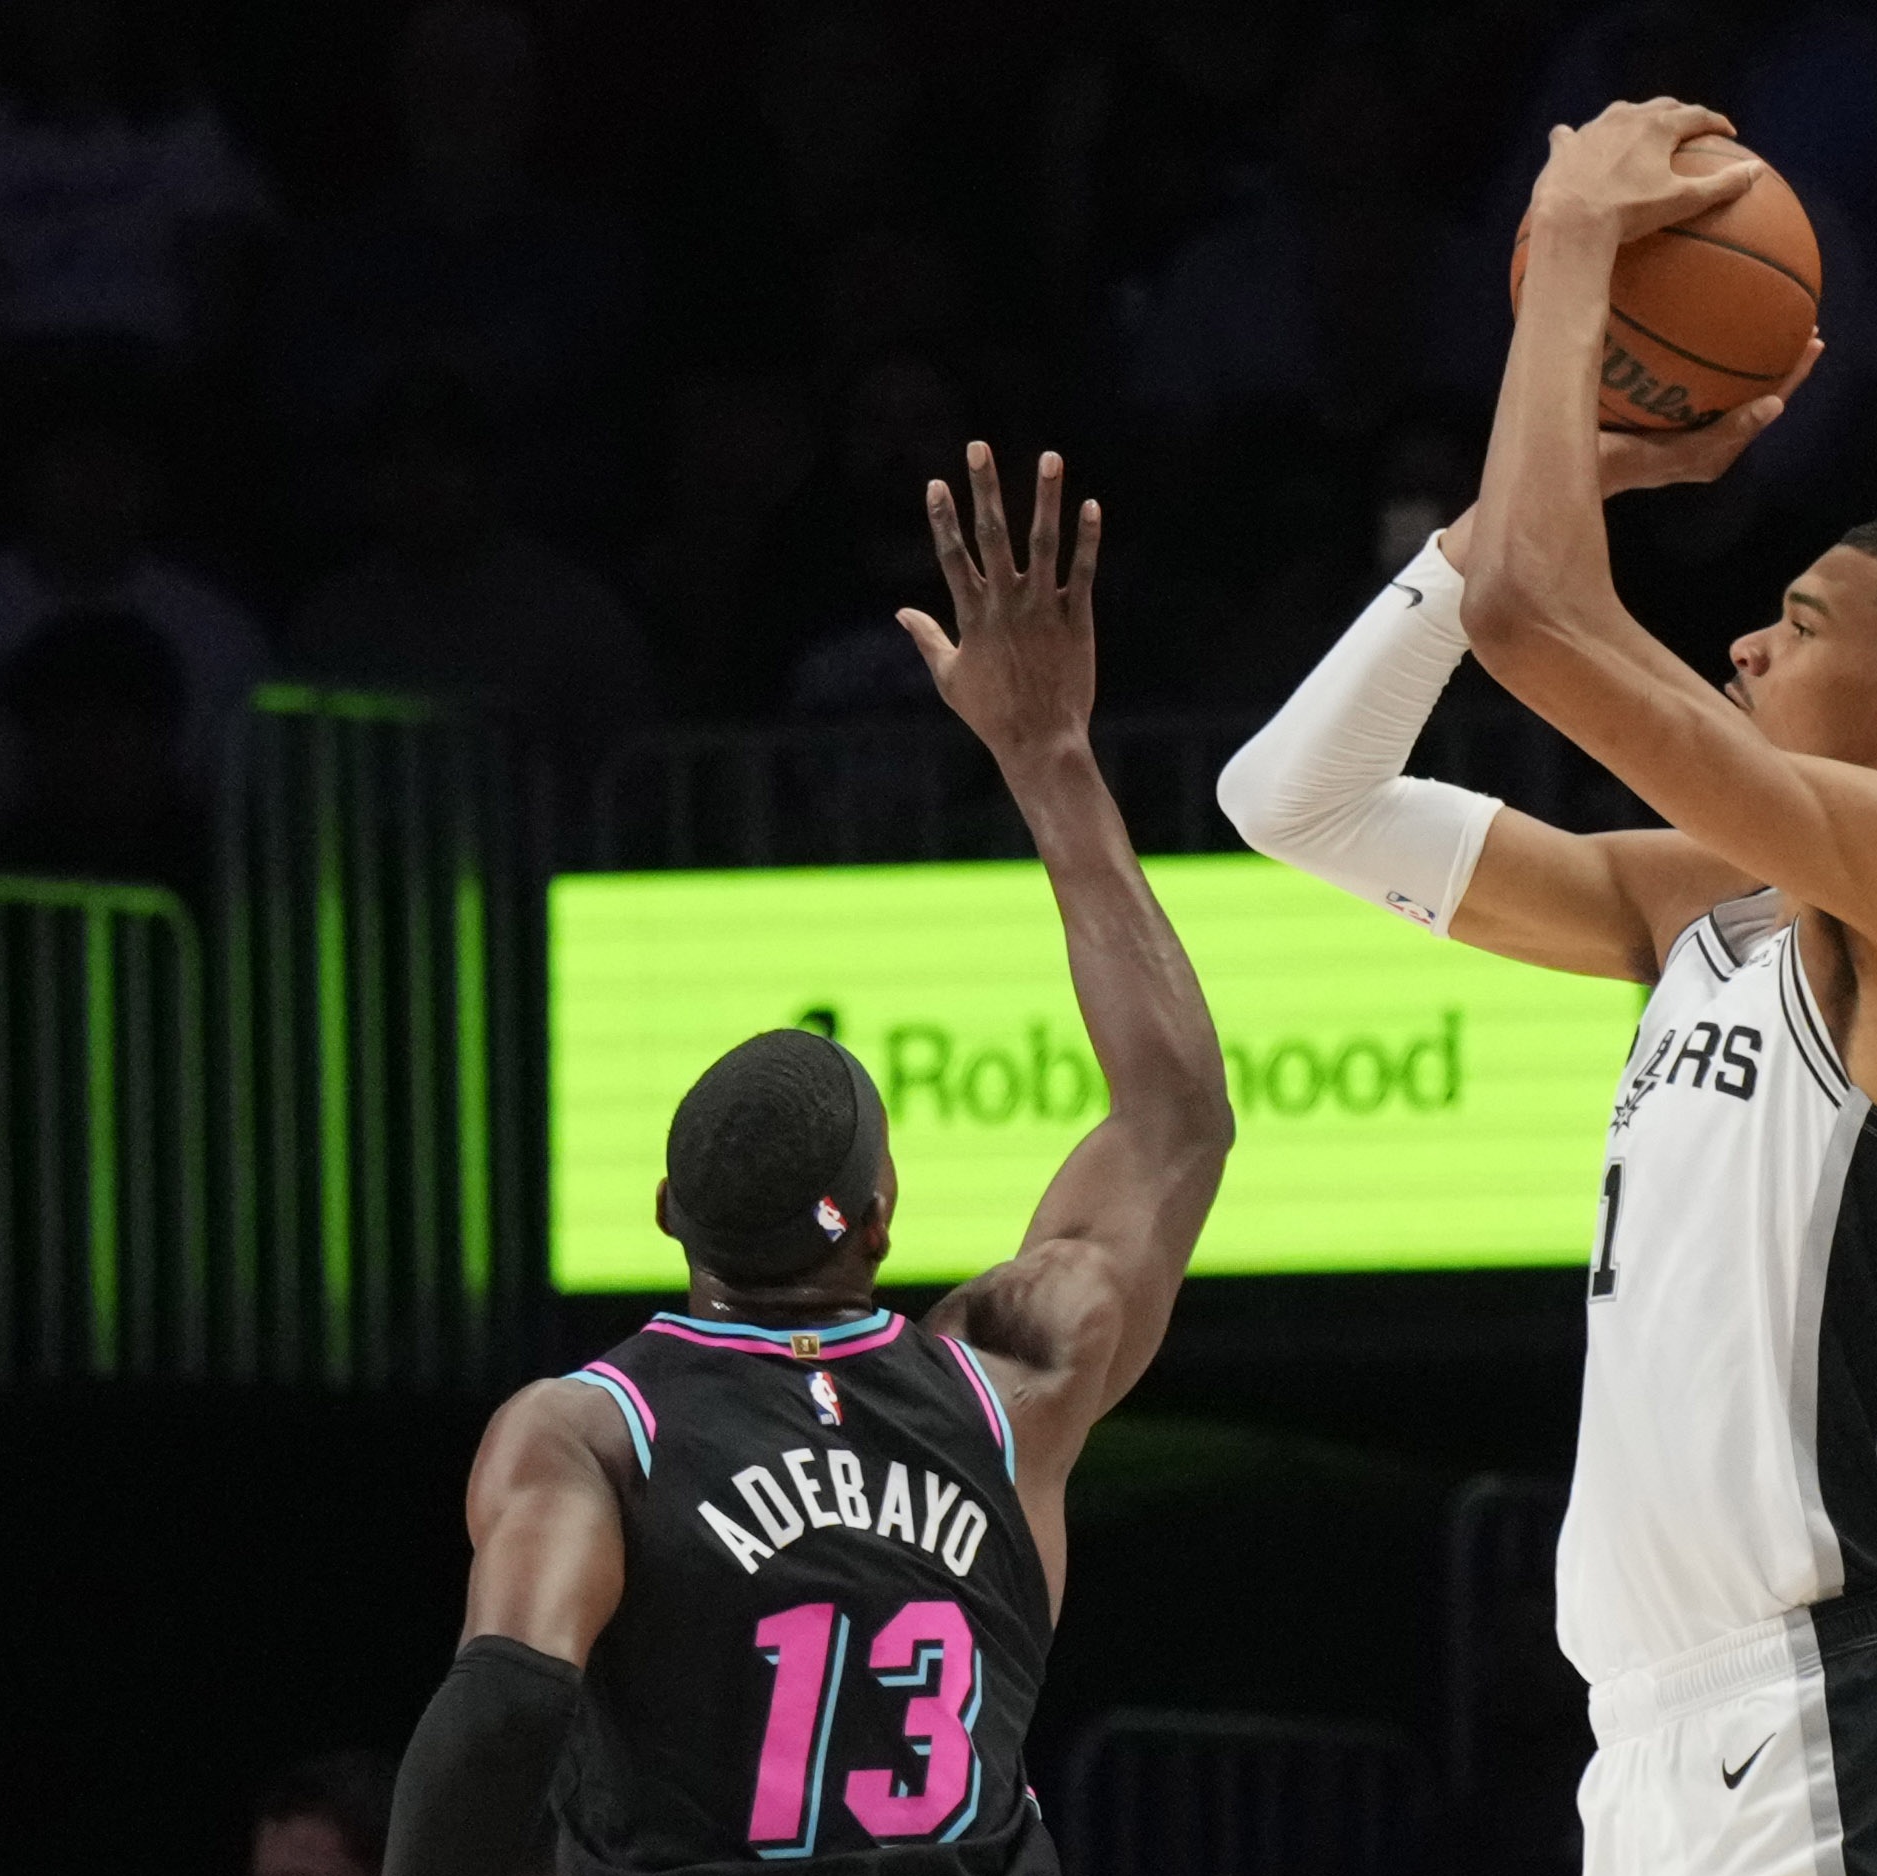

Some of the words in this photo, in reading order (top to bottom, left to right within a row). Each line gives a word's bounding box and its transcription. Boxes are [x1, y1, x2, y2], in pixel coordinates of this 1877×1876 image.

[885, 1006, 1459, 1123] Robood
[1579, 1159, 1624, 1300] 1
[697, 1447, 988, 1578] ADEBAYO
[748, 1600, 983, 1860] 13
